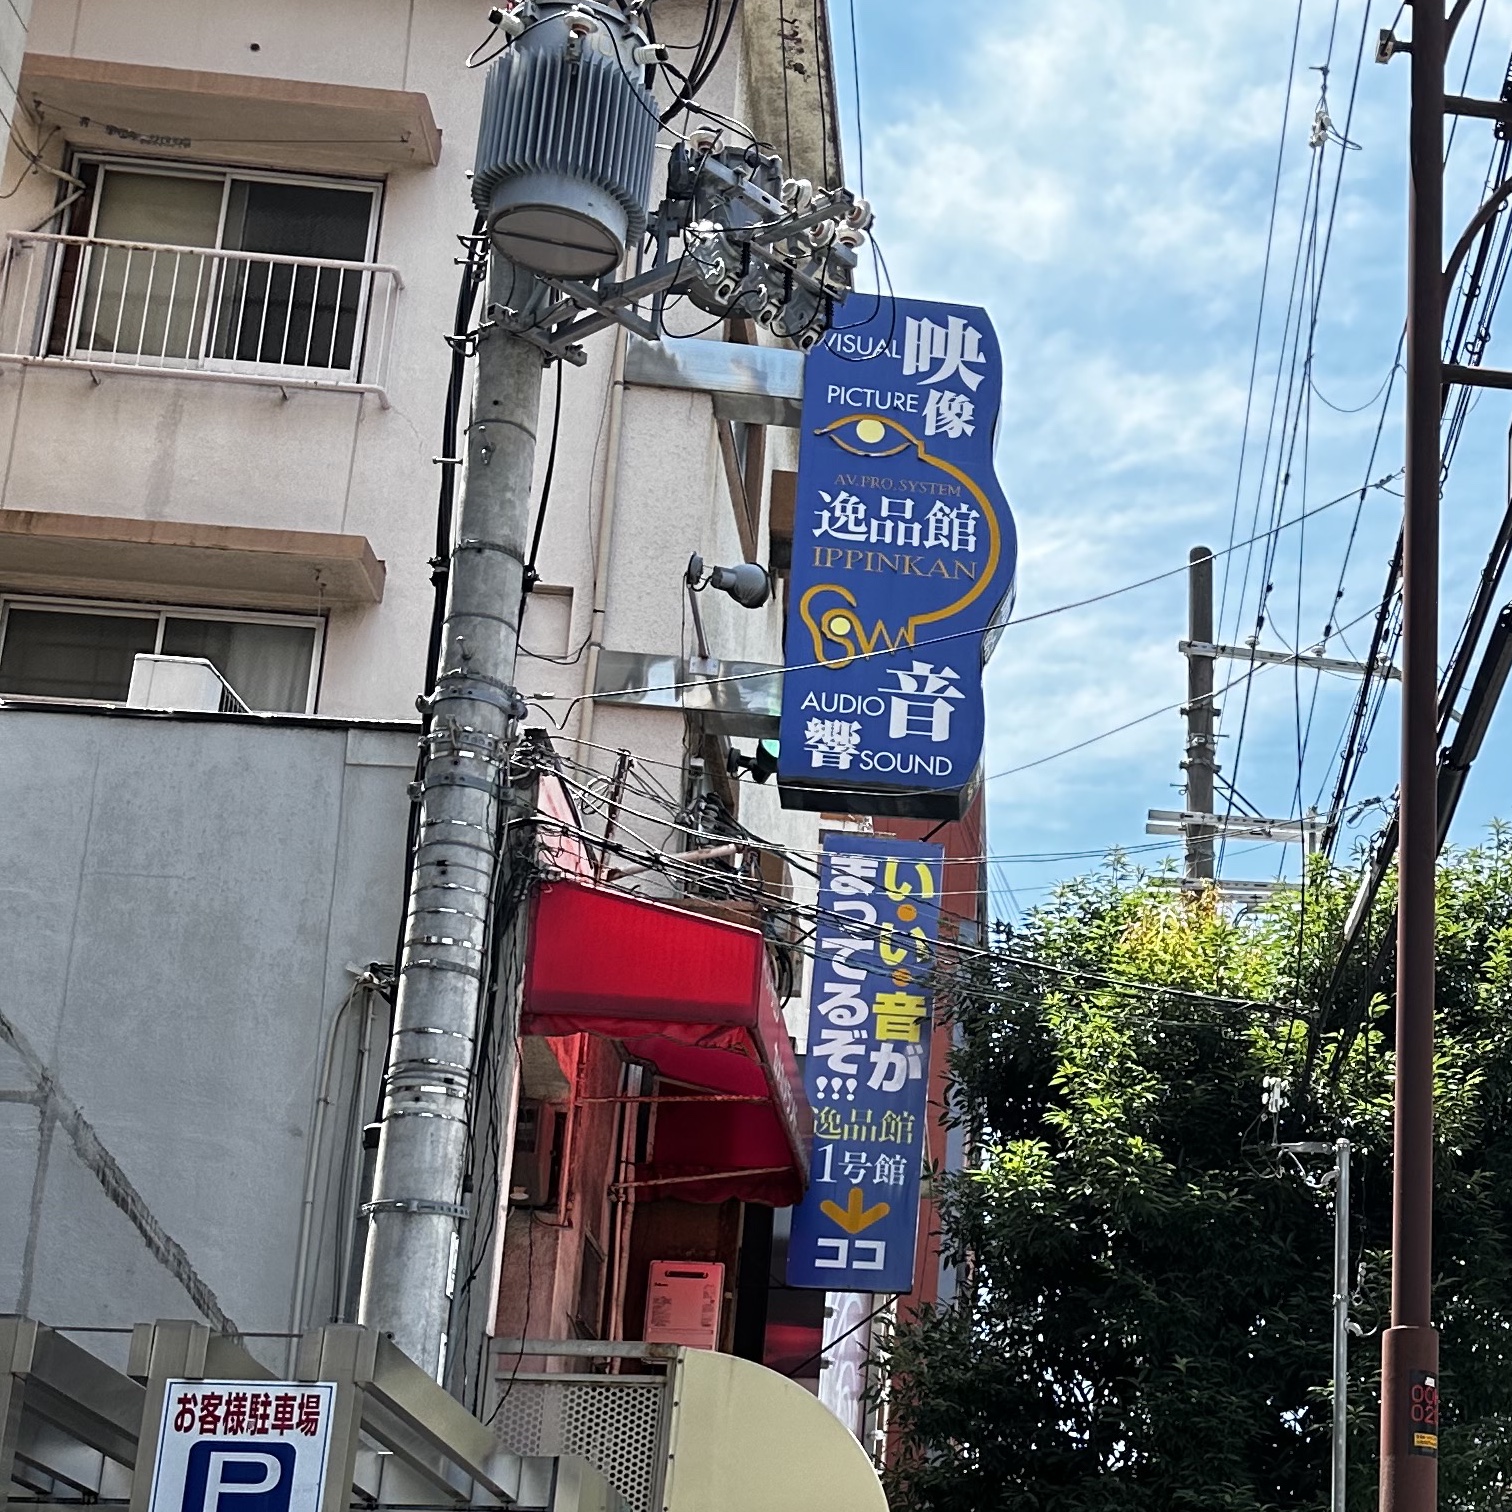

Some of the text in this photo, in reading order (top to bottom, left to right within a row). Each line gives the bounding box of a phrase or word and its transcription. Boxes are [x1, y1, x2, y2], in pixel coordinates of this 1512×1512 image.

[822, 333, 902, 359] VISUAL
[827, 385, 919, 413] PICTURE
[812, 489, 980, 553] 逸品館
[812, 545, 977, 581] IPPINKAN
[801, 690, 886, 716] AUDIO
[859, 750, 952, 776] SOUND
[812, 1107, 916, 1146] 逸品館
[815, 1144, 908, 1186] 1号館
[815, 1237, 887, 1271] ココ
[173, 1392, 322, 1438] お客様駐車場
